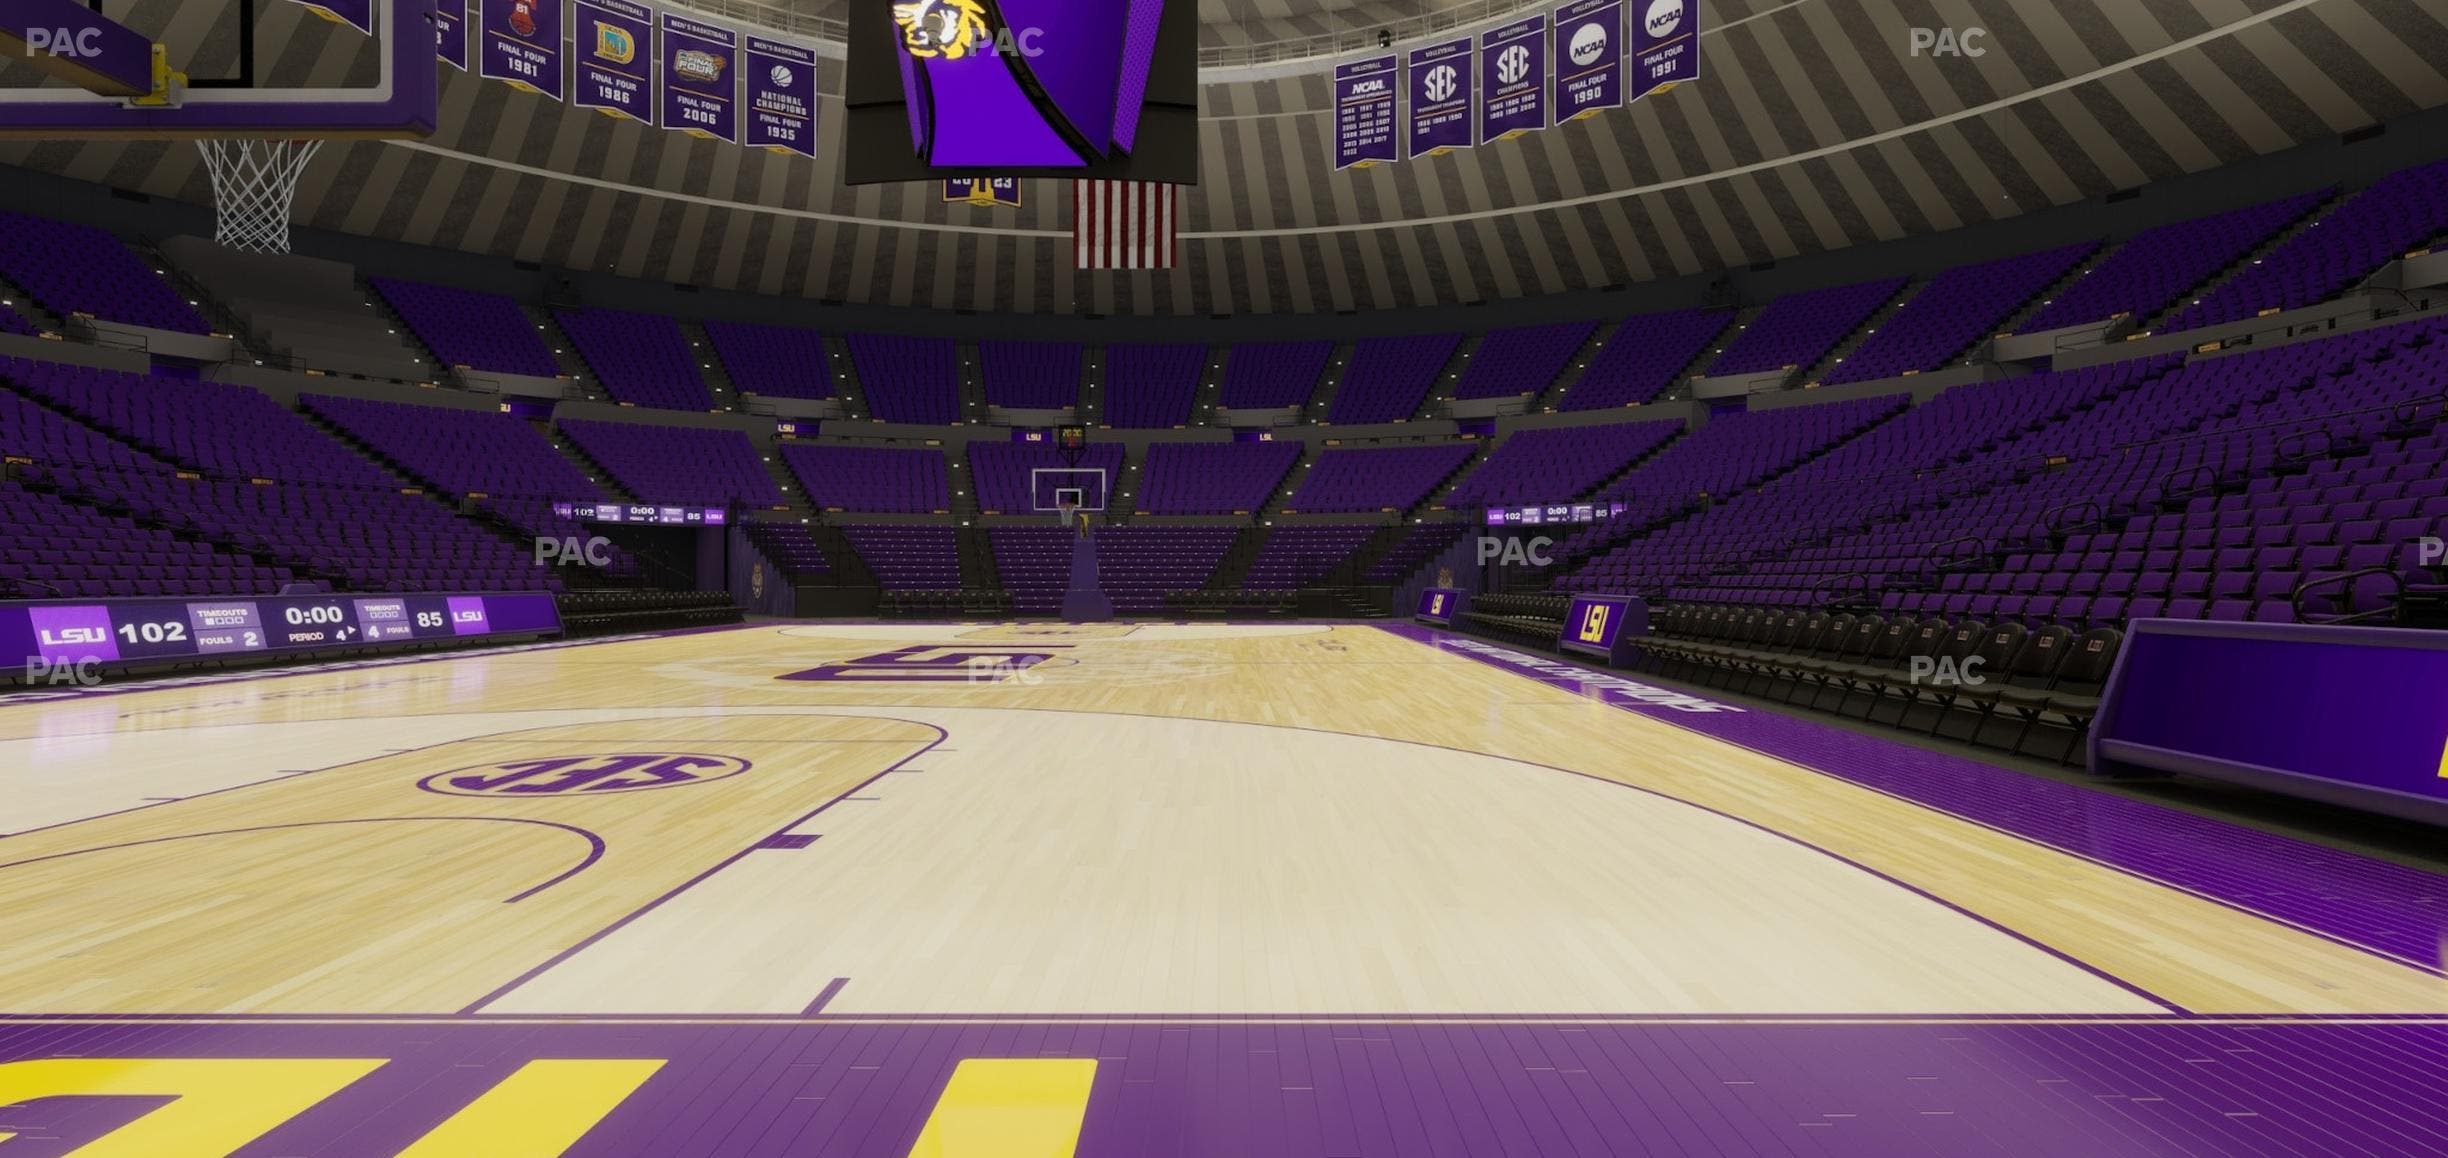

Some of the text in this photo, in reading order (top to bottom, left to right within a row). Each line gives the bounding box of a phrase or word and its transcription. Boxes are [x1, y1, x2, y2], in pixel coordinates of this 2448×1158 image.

[1649, 8, 1681, 30] NCAA
[498, 42, 547, 64] FINAL FOUR
[1574, 39, 1604, 58] NCAA
[1644, 45, 1684, 66] FINAL FOUR
[508, 57, 538, 77] 1981
[1496, 45, 1530, 84] SEC
[1652, 59, 1677, 79] 1991
[591, 72, 638, 92] FINAL FOUR
[1352, 80, 1385, 94] NCAA
[1424, 65, 1457, 102] SEC
[1568, 73, 1608, 92] FINAL FOUR
[599, 86, 630, 104] 1986
[761, 90, 801, 106] NATIONAL
[1574, 86, 1602, 105] 1990
[677, 95, 722, 113] FINAL FOUR
[756, 98, 807, 115] CHAMPIONS
[683, 108, 717, 125] 2006
[760, 114, 802, 128] FINAL FOUR
[767, 126, 796, 141] 1935
[778, 424, 795, 433] LSU
[1026, 433, 1041, 441] LSU
[573, 508, 595, 517] 102
[630, 506, 655, 515] 0:00
[1504, 512, 1521, 520] 102
[1547, 507, 1568, 515] 0:00
[197, 608, 248, 618] TIMEOUTS
[285, 606, 343, 625] 0:00
[364, 604, 400, 612] TIMEOUTS
[416, 611, 483, 627] 85 LSU
[1580, 604, 1610, 643] LSU
[41, 622, 187, 646] LSU 102
[200, 631, 259, 647] FOULS 2
[289, 630, 346, 642] PERIOD 4
[368, 625, 409, 638] 4 FOULS
